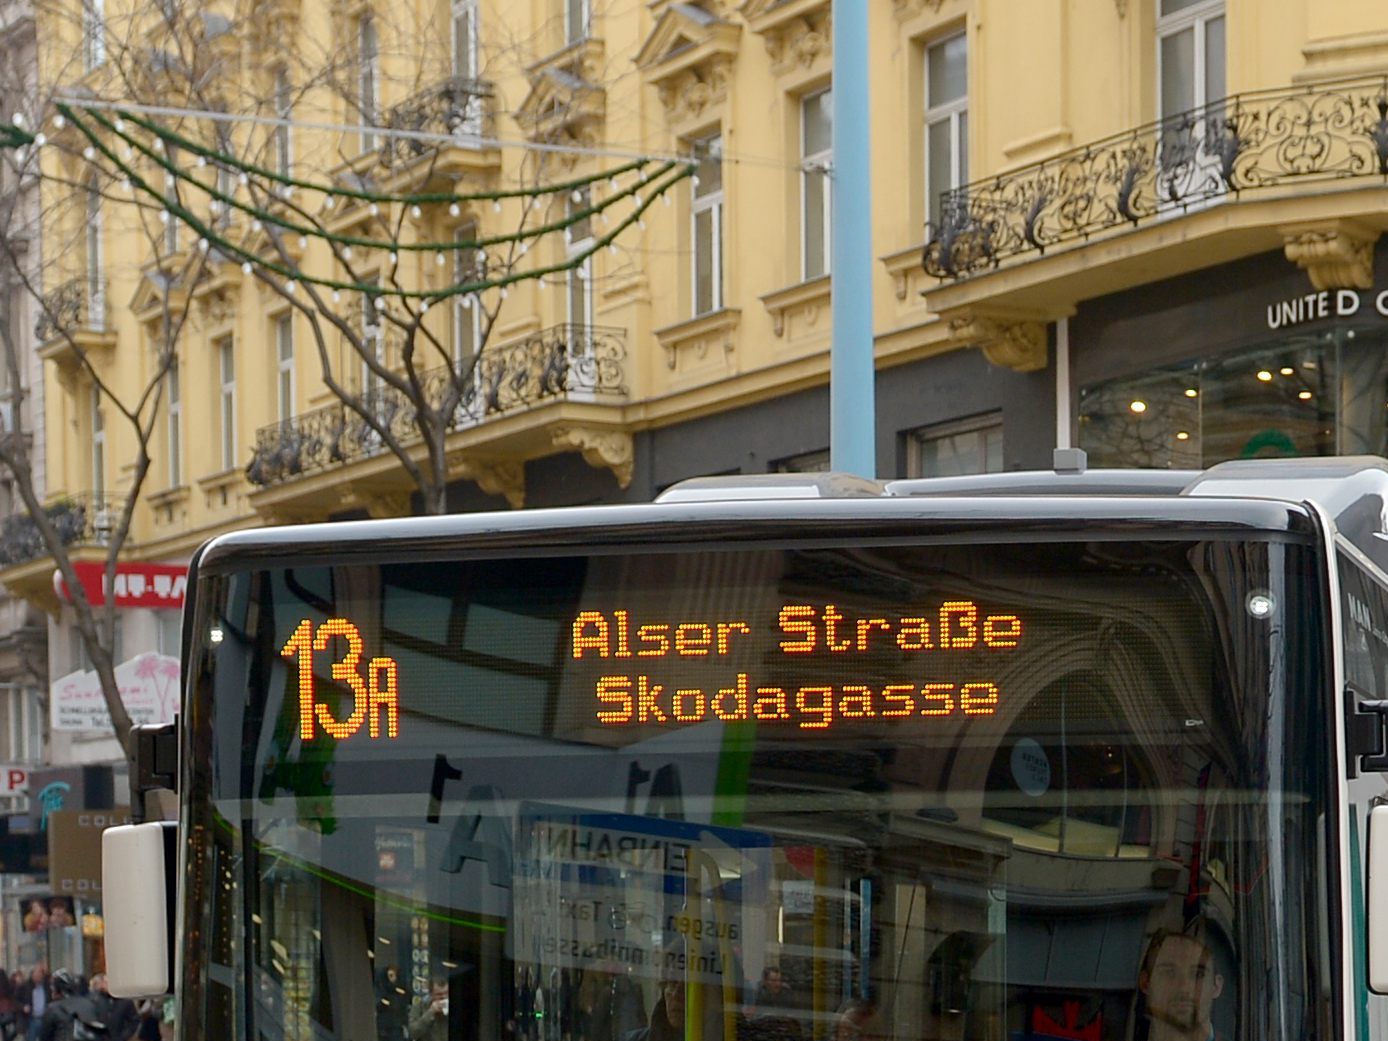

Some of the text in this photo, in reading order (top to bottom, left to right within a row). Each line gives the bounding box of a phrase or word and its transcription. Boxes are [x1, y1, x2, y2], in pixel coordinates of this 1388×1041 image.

[1266, 288, 1360, 329] UNITED
[571, 600, 1024, 660] Alser Straße
[280, 617, 400, 741] 13A
[595, 674, 1001, 730] Skodagasse
